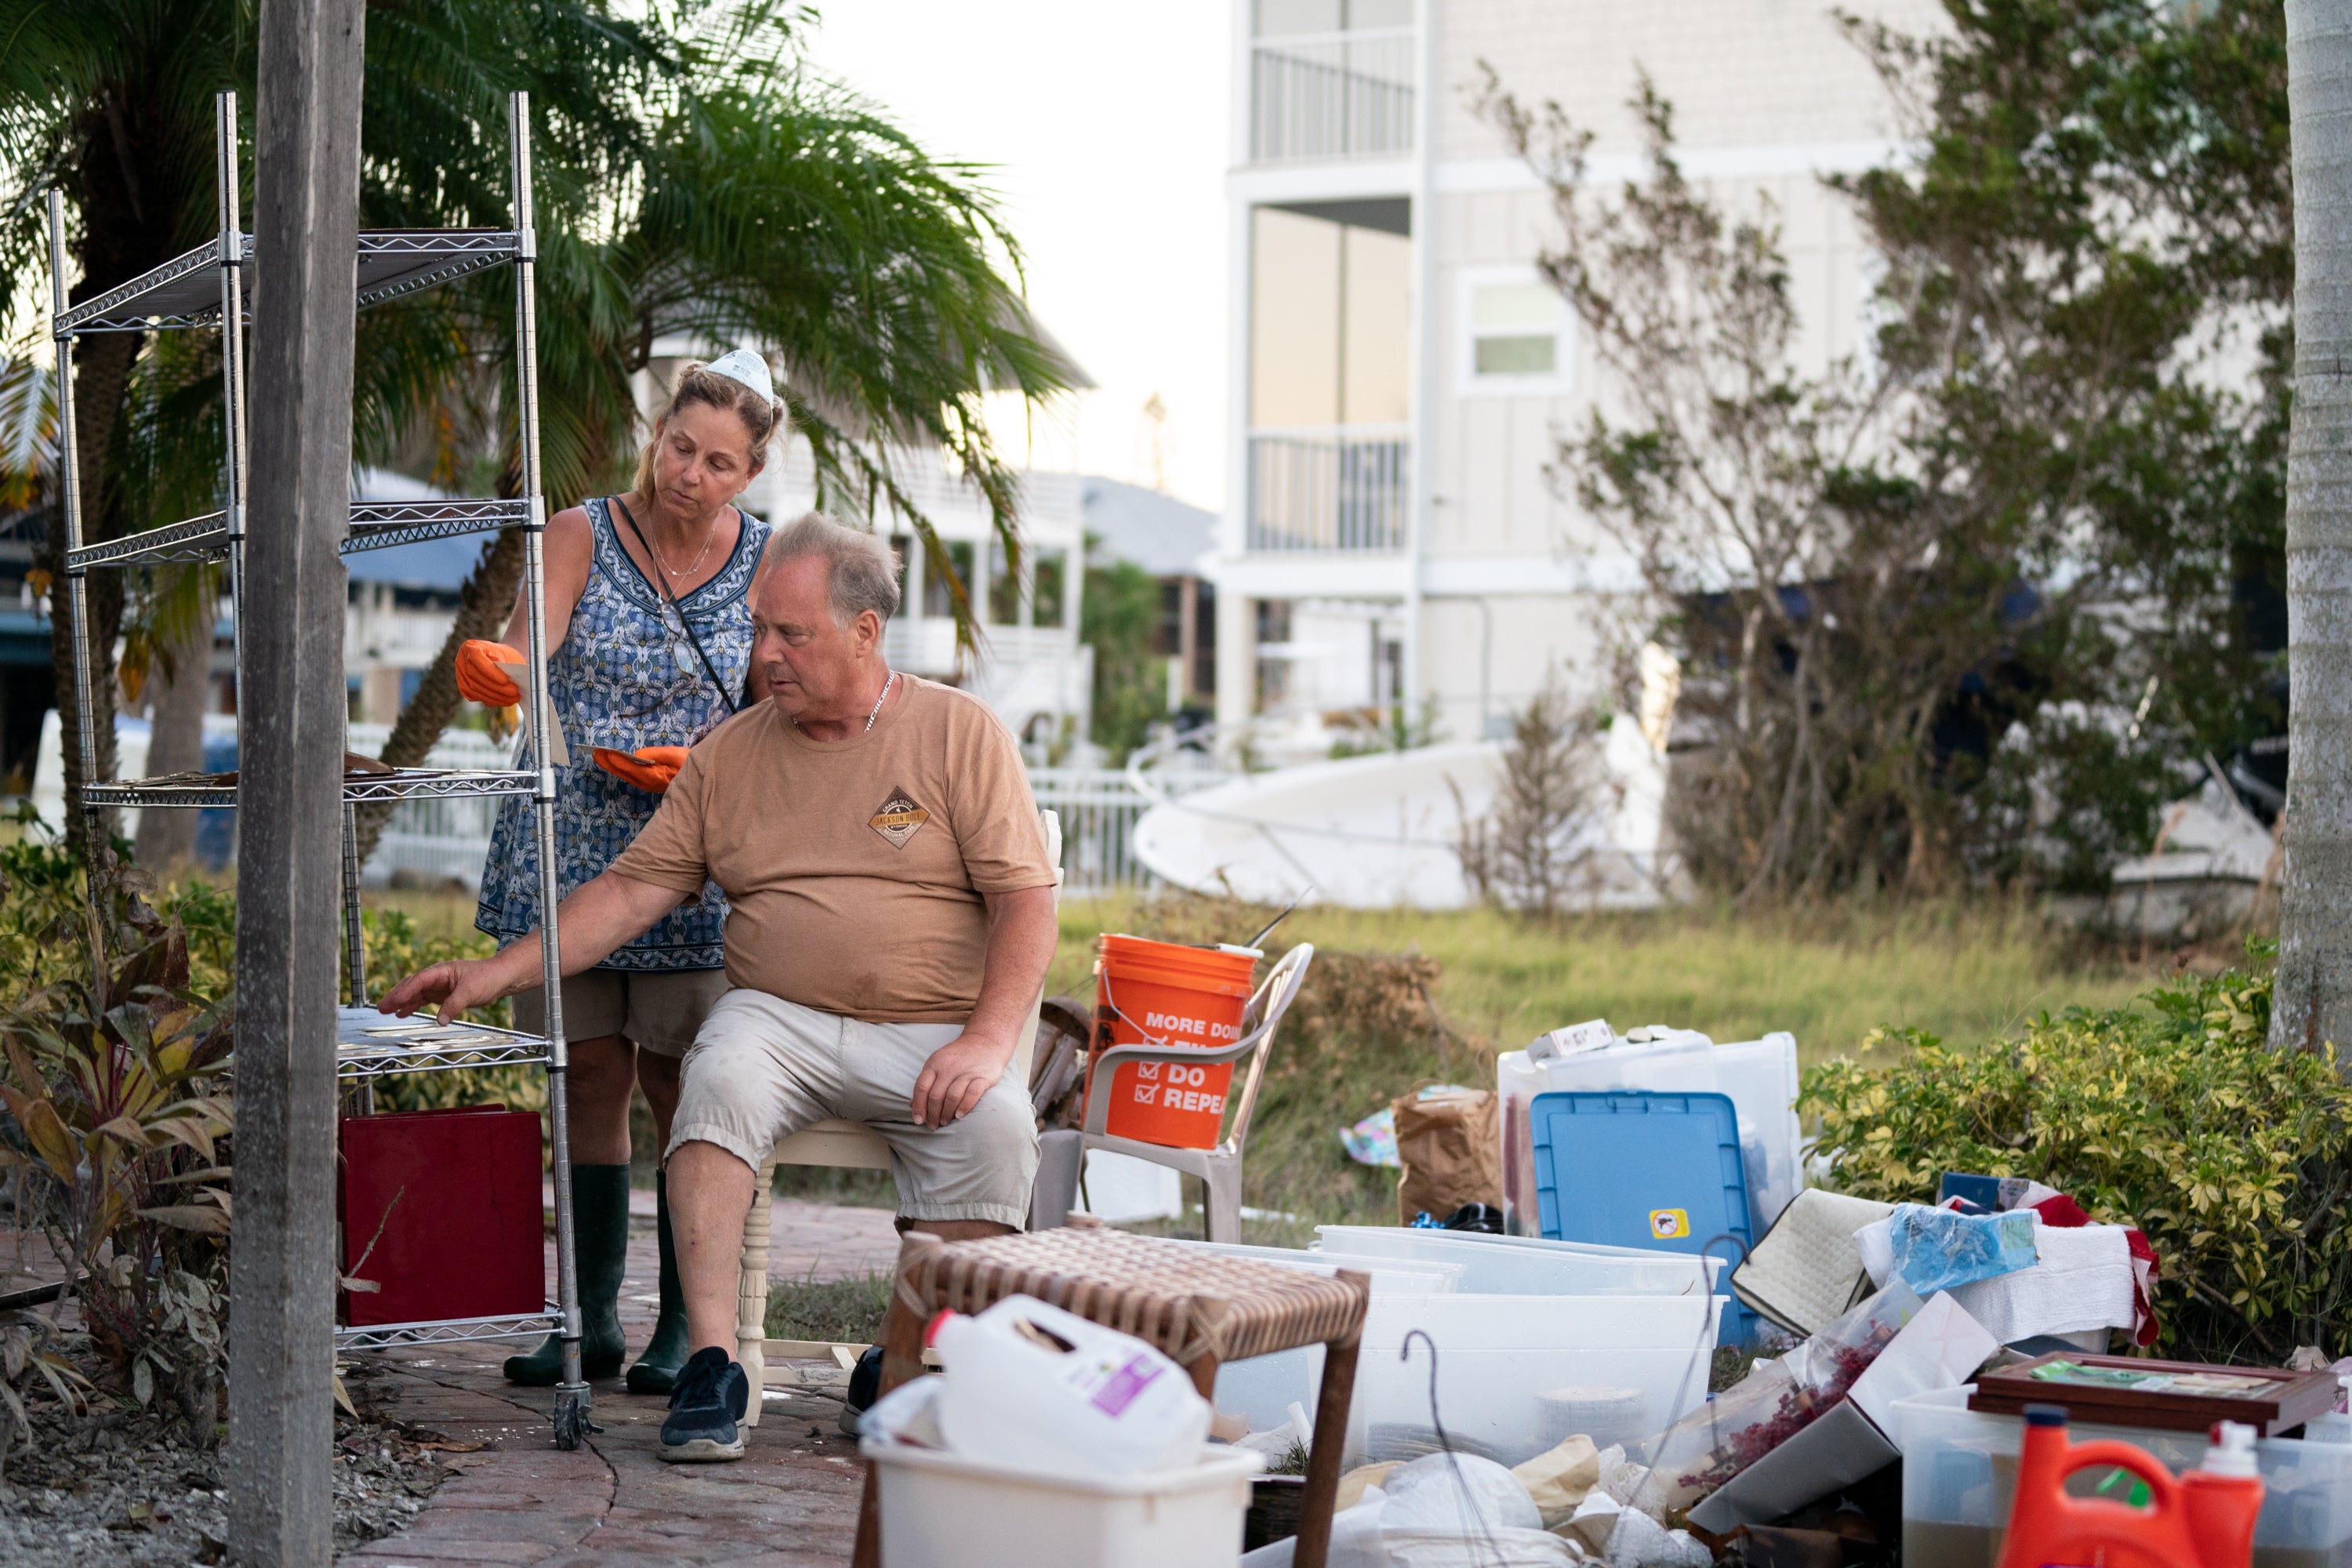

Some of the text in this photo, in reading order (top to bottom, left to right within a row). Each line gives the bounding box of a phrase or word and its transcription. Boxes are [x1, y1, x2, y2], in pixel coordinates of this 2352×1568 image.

[883, 800, 913, 813] GRAND TETON
[876, 812, 920, 826] JACKSON HOLE
[884, 829, 904, 837] NATIONAL
[1145, 1011, 1207, 1036] MORE
[1167, 1063, 1206, 1087] DO
